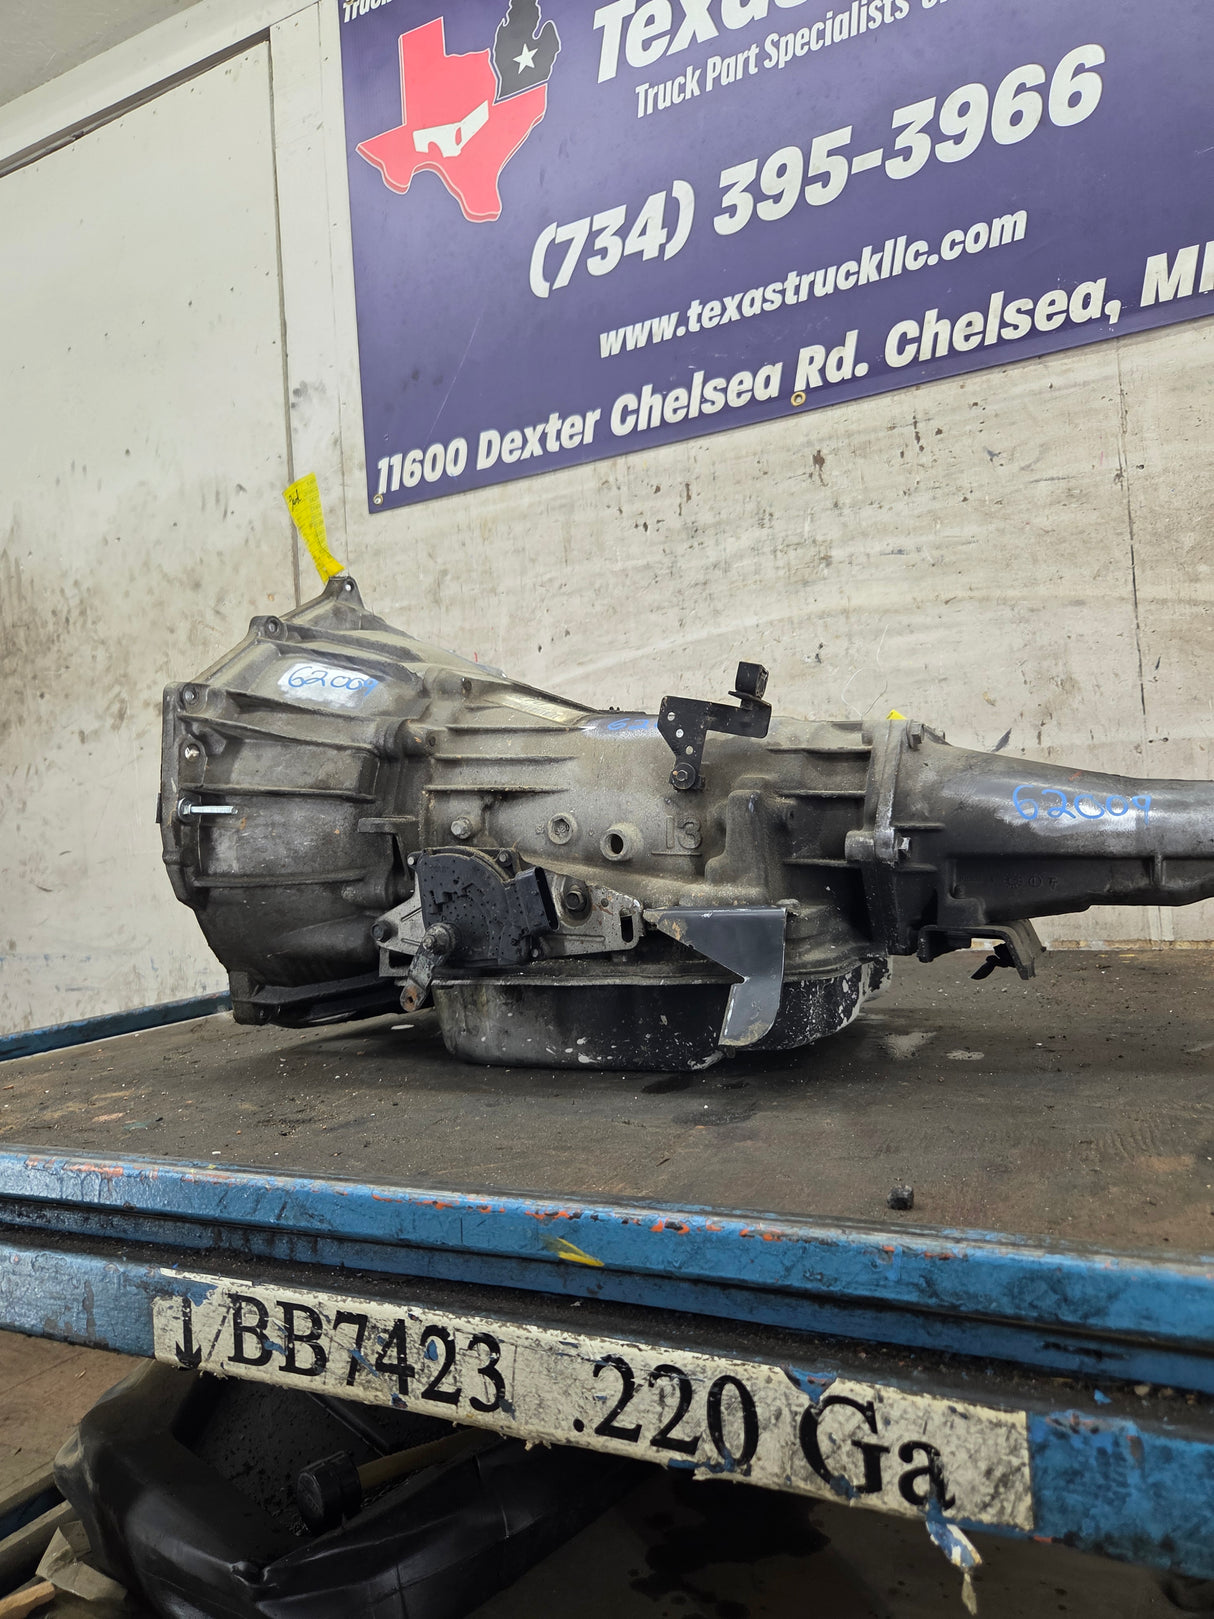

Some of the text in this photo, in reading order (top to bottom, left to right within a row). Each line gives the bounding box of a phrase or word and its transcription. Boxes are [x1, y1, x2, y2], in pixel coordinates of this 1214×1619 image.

[343, 0, 392, 23] Truc
[635, 0, 909, 118] Truck Part Specialists
[529, 44, 1106, 298] (734) 395-3966
[600, 210, 1028, 358] www.texastruckllc.com
[377, 438, 468, 495] 11600
[476, 409, 601, 470] Dexter
[610, 362, 784, 437] Chelsea
[794, 330, 869, 392] Rd.
[884, 277, 1122, 368] Chelsea,
[288, 666, 379, 697] 62009
[1012, 784, 1152, 826] 62009
[227, 1293, 955, 1511] BB7423 .220 Ga
